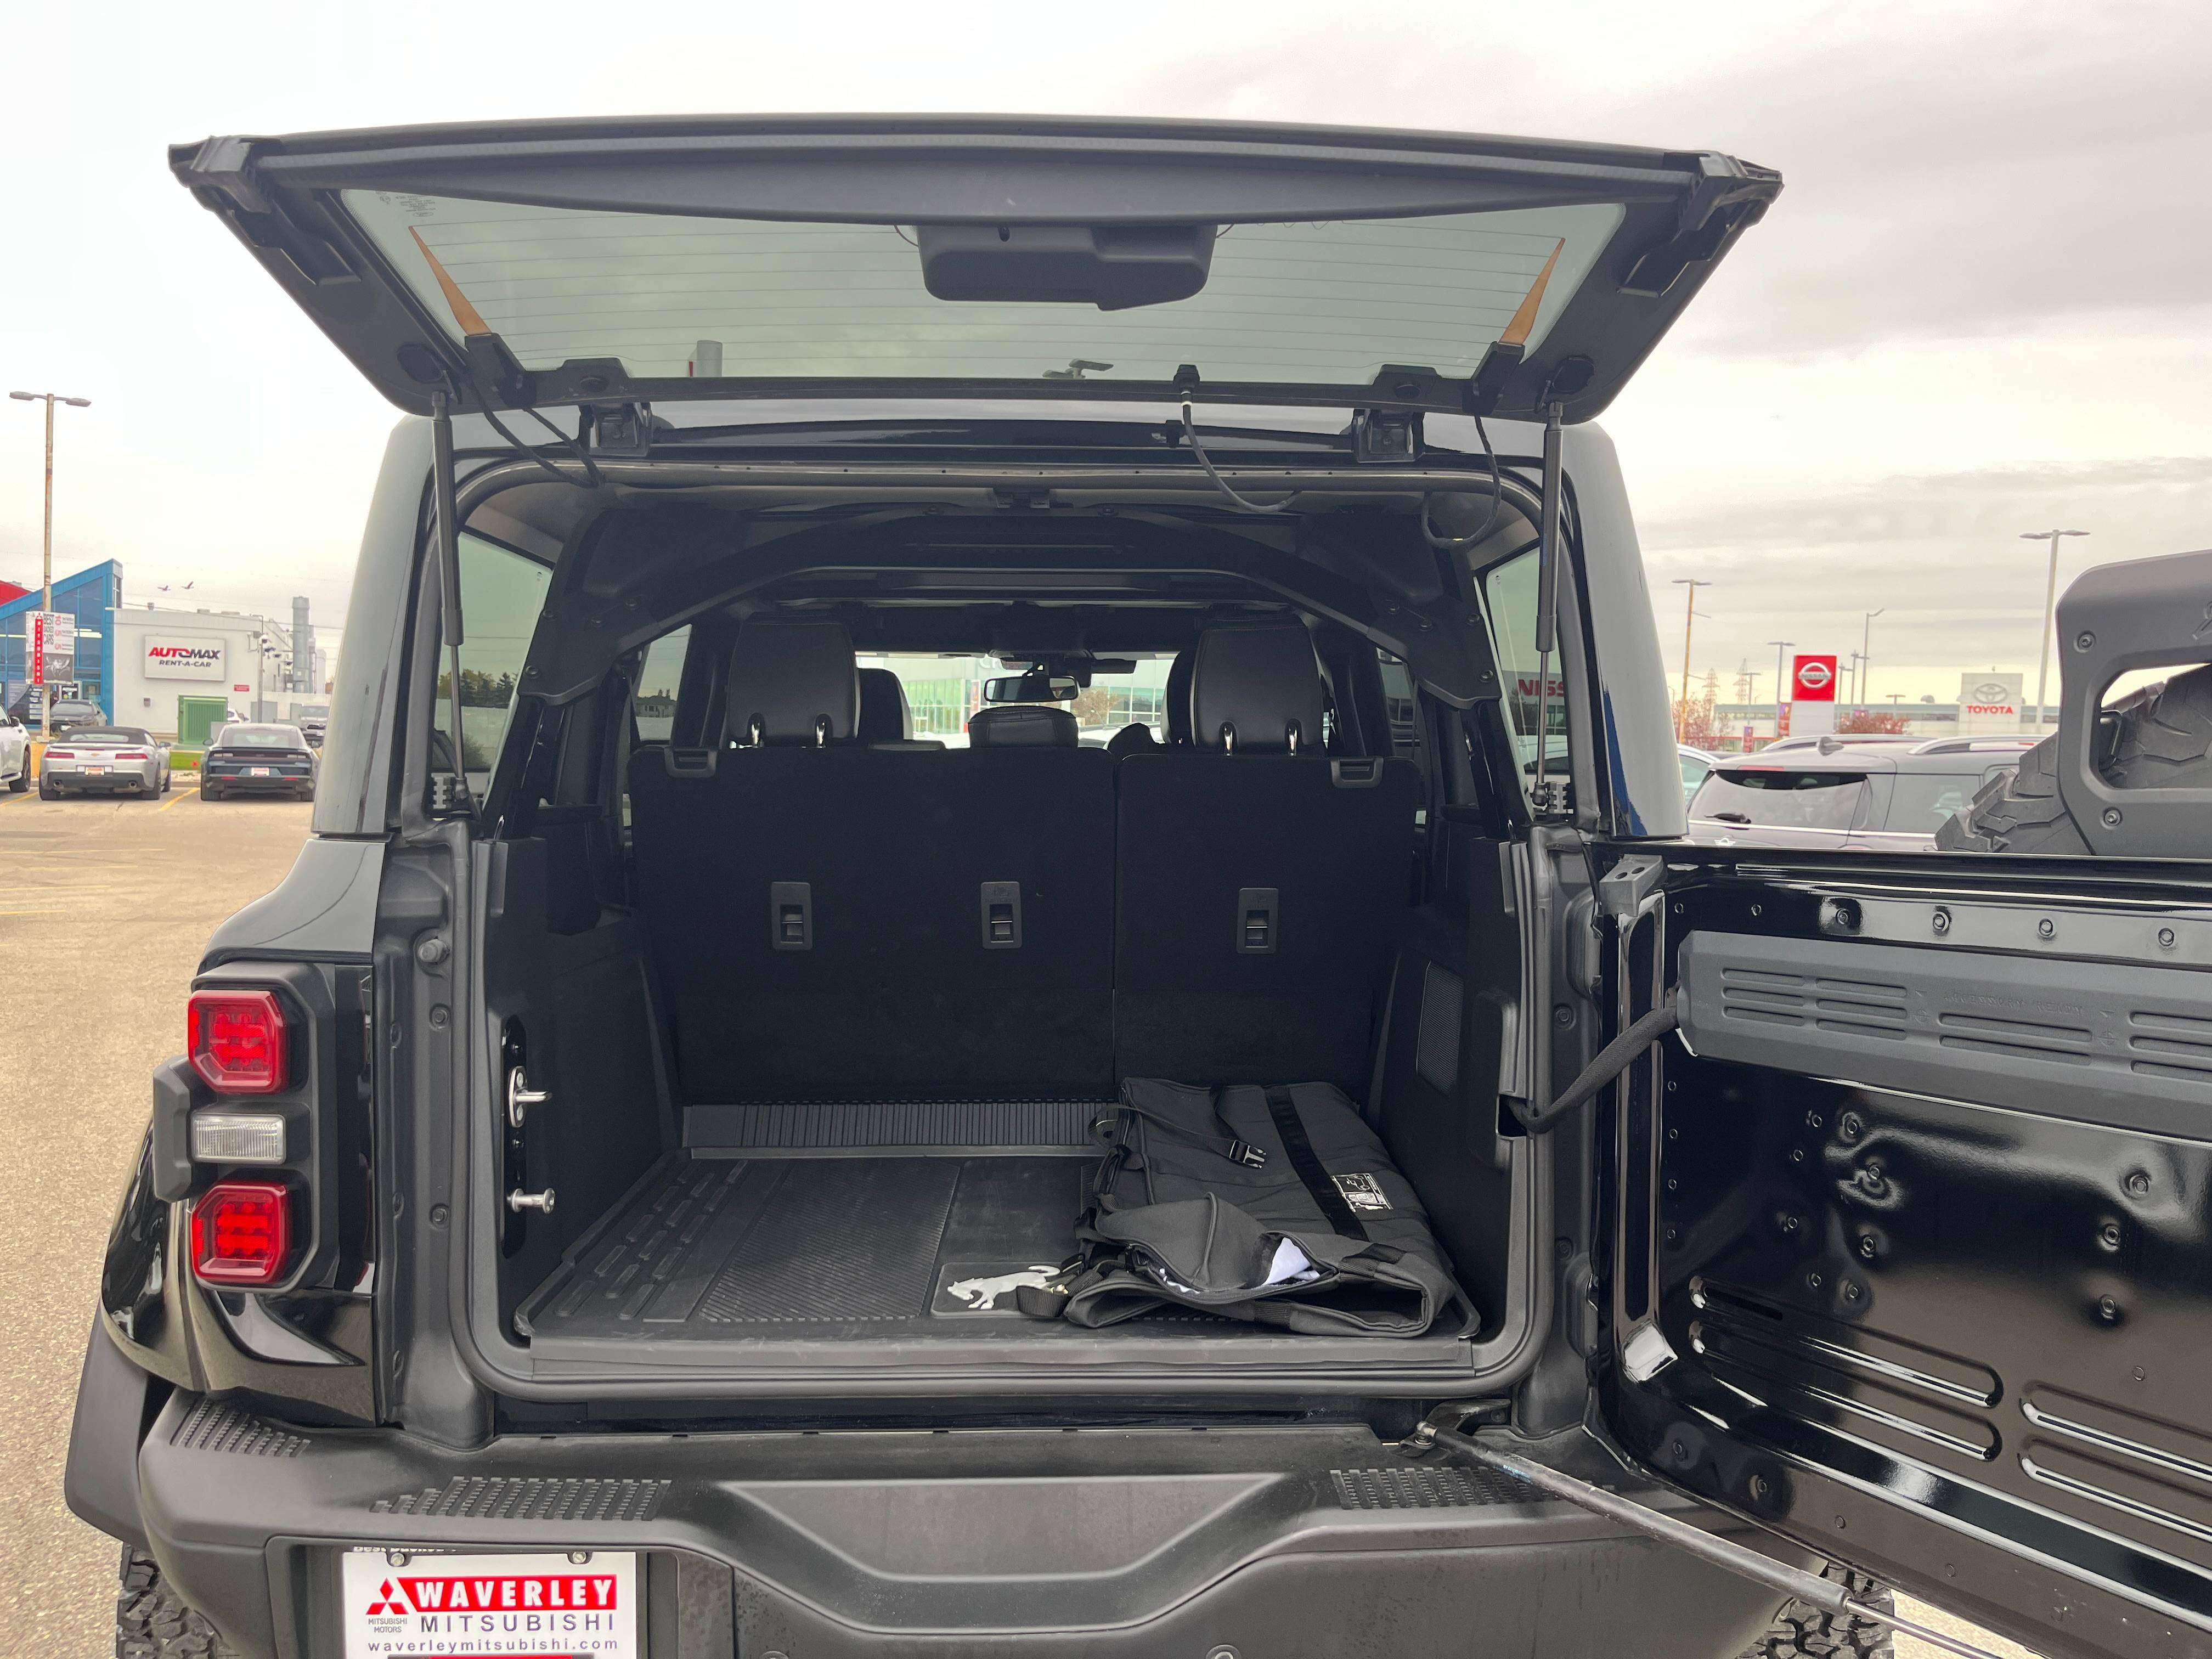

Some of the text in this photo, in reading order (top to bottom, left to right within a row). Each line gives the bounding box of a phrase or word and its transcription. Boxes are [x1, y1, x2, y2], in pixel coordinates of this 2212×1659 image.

[149, 647, 221, 659] AUTOMAX
[1967, 705, 2013, 714] TOYOTA
[415, 1579, 613, 1608] WAVERLEY
[368, 1617, 408, 1626] MITSUBISHI
[421, 1613, 614, 1633] MITSUBISHI
[368, 1638, 618, 1654] waverleymitsubishi.com
